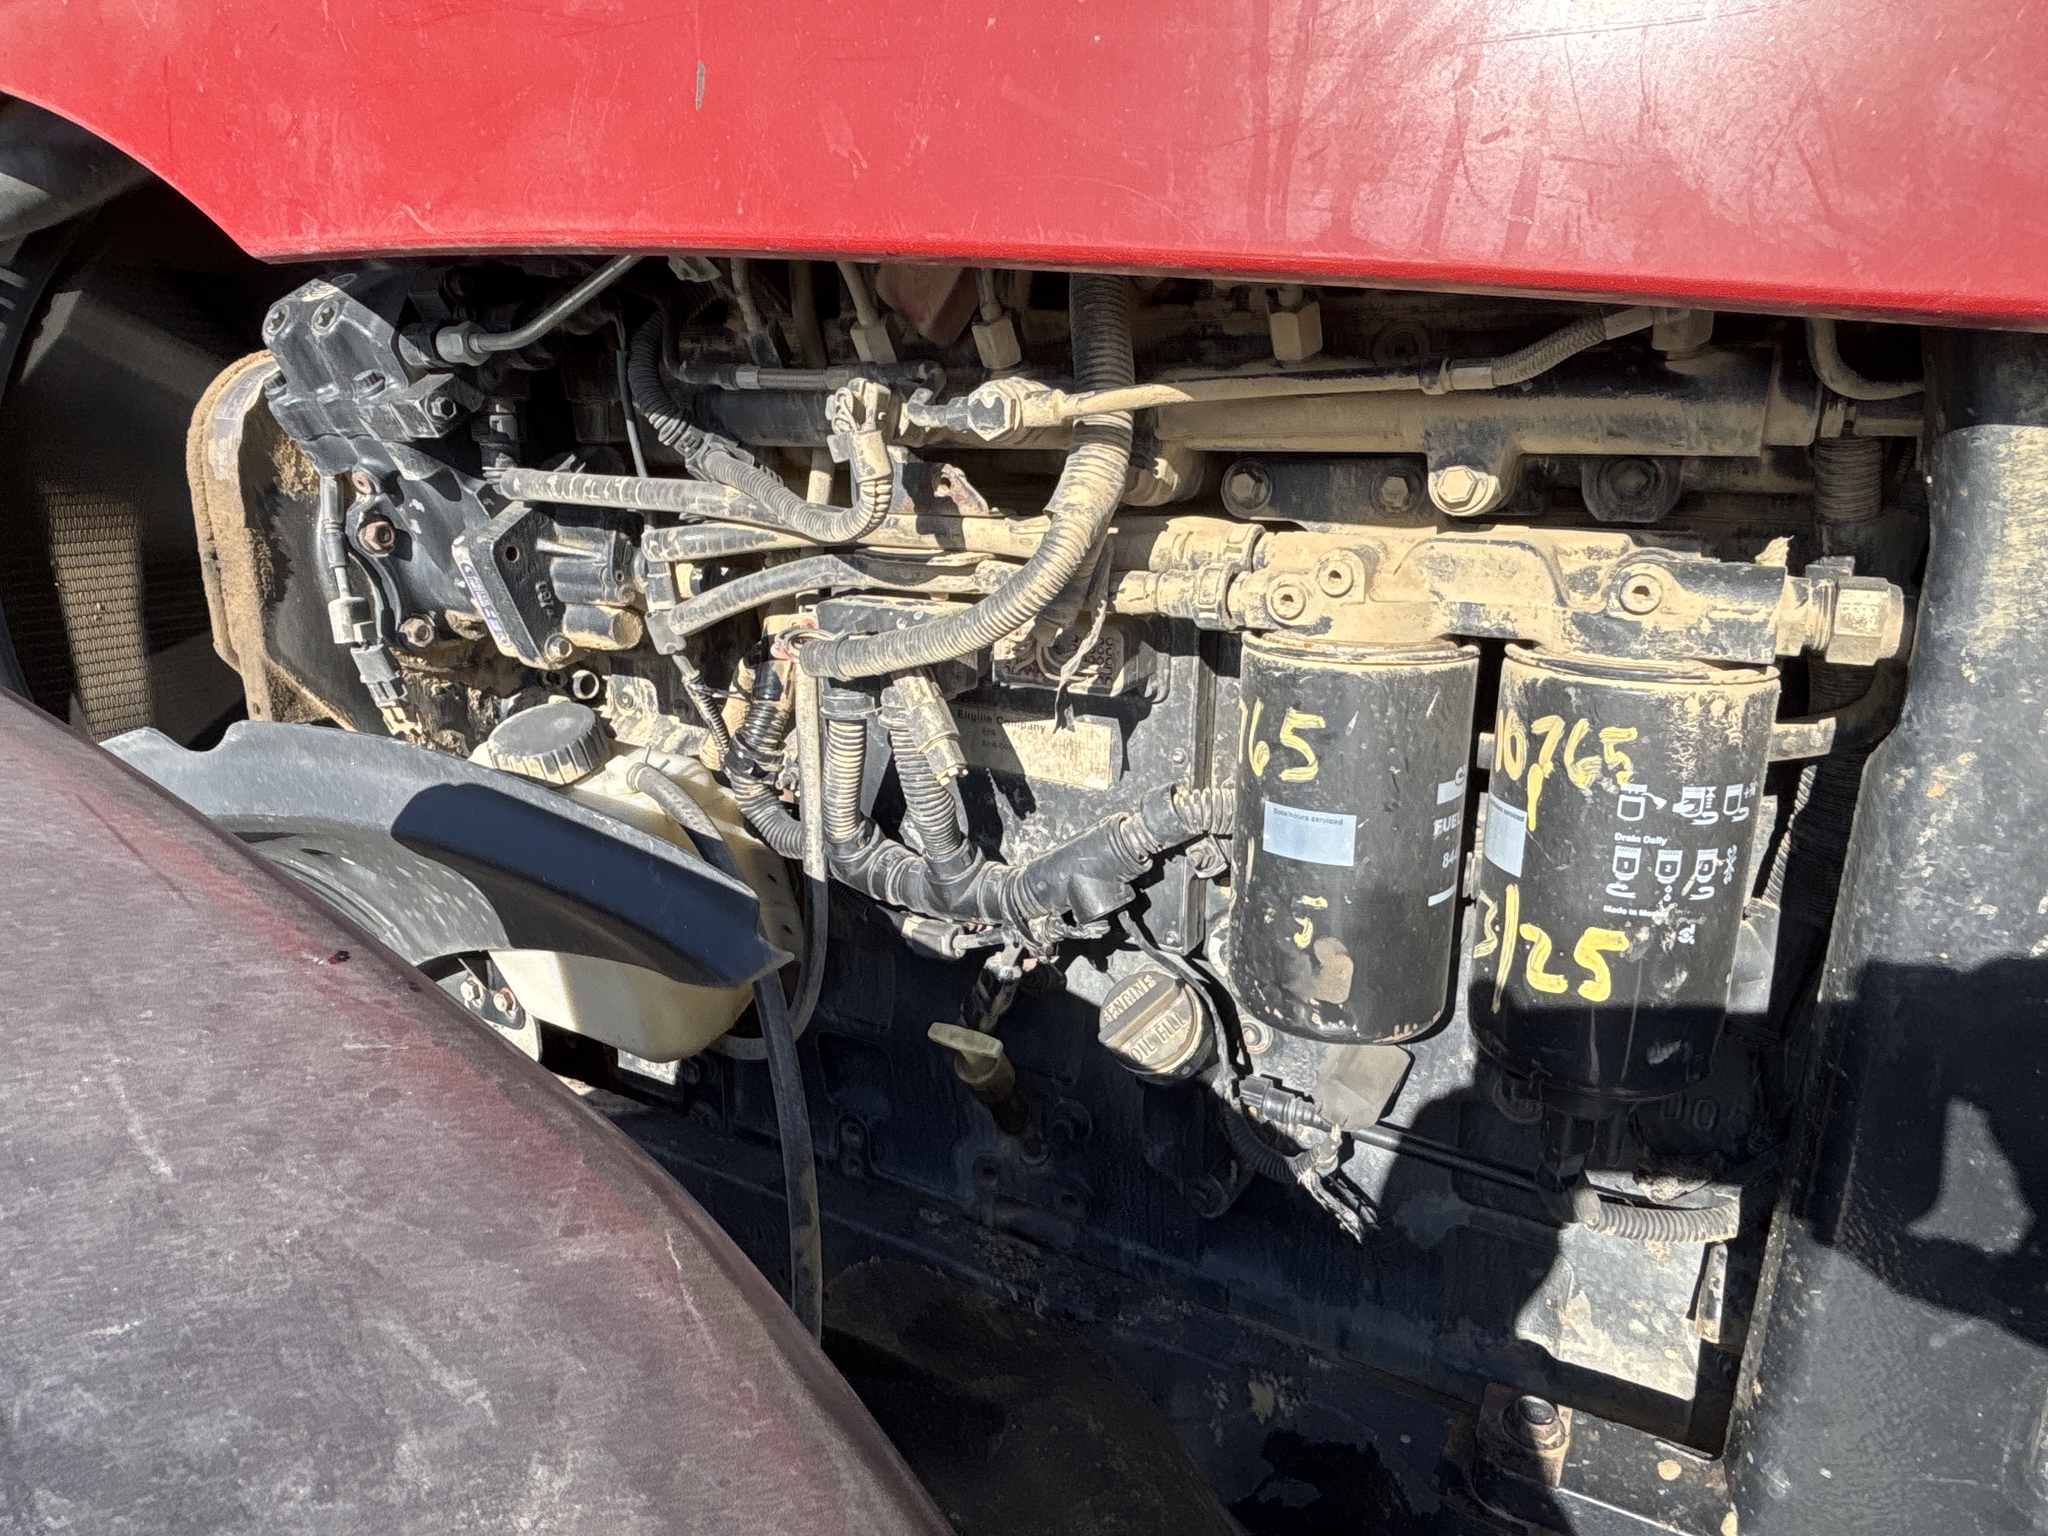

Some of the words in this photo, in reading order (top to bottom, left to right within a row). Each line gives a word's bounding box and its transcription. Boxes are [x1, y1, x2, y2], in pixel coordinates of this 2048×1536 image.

[957, 709, 992, 723] Engine
[996, 716, 1046, 734] Company
[1311, 816, 1344, 826] serviced
[1614, 832, 1642, 844] Drain
[1643, 835, 1668, 847] Daily
[1664, 864, 1672, 873] 2
[1602, 904, 1628, 916] Made
[1628, 907, 1638, 916] in
[1103, 974, 1156, 1023] ENGINE
[1129, 1038, 1158, 1063] OIL
[1155, 1011, 1188, 1043] FILL
